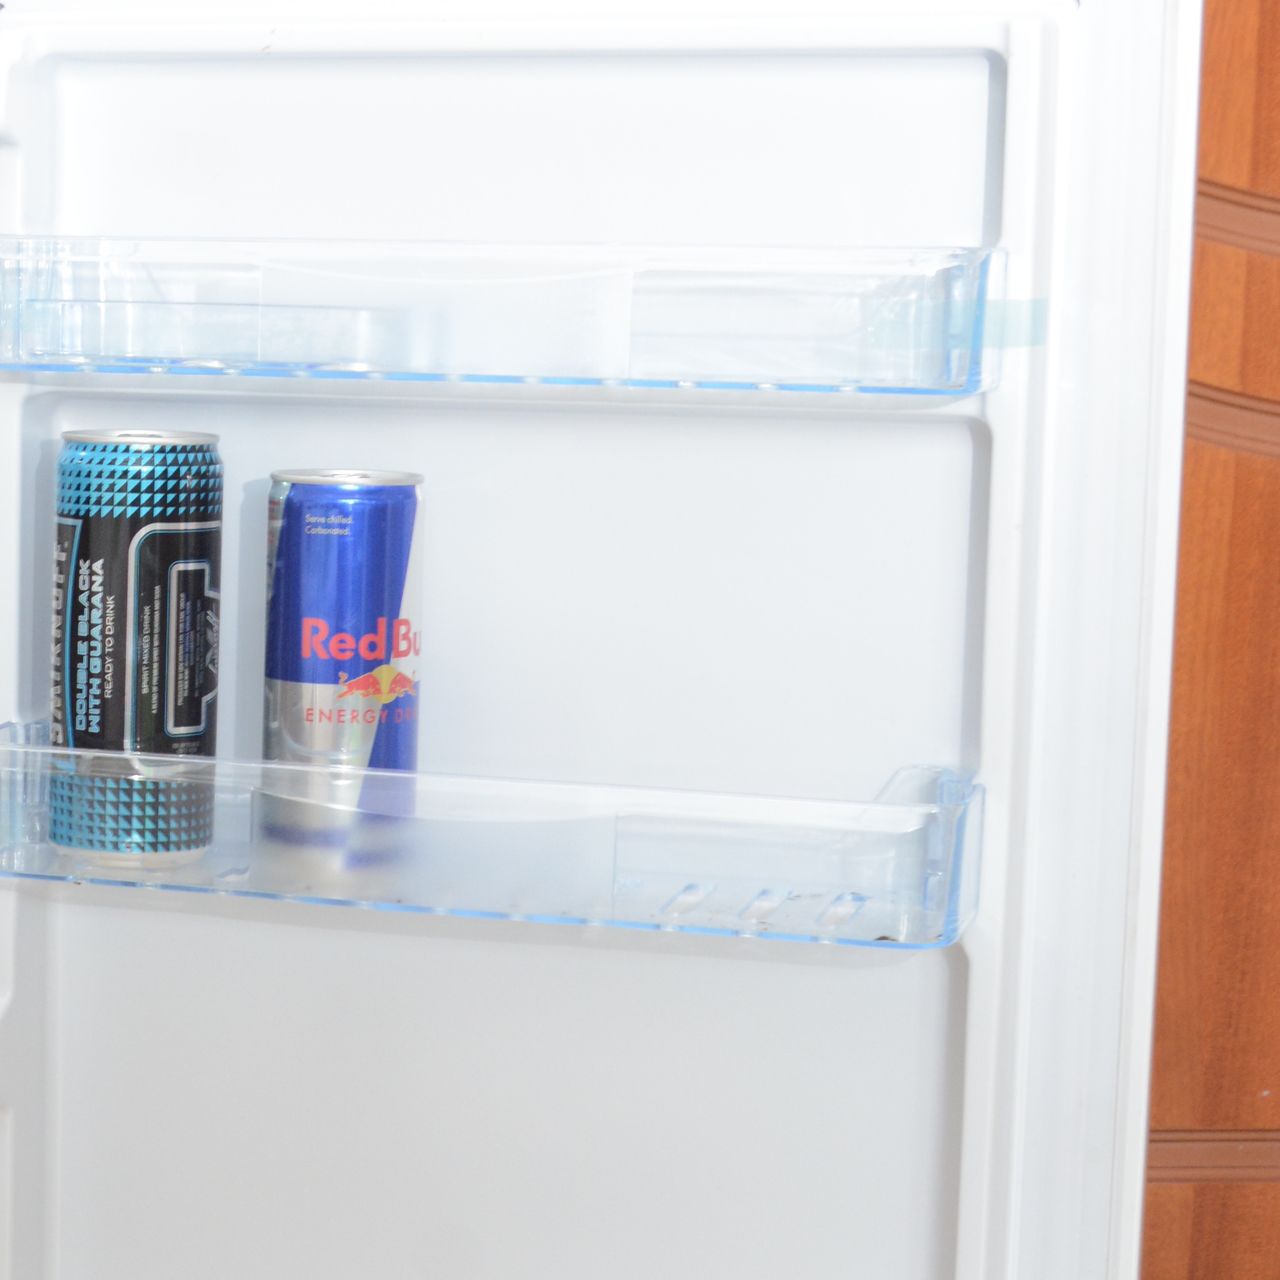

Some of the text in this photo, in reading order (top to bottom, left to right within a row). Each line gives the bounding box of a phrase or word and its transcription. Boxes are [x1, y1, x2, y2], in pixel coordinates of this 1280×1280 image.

[305, 515, 326, 524] Serve
[75, 559, 91, 732] DOUBLE BLACK
[88, 558, 104, 734] WITH GUARANA
[103, 595, 115, 698] READY TO DRINK
[141, 605, 152, 694] SPIRIT MIXED DRINK
[301, 617, 387, 660] Red
[304, 707, 418, 724] ENERGY DR
